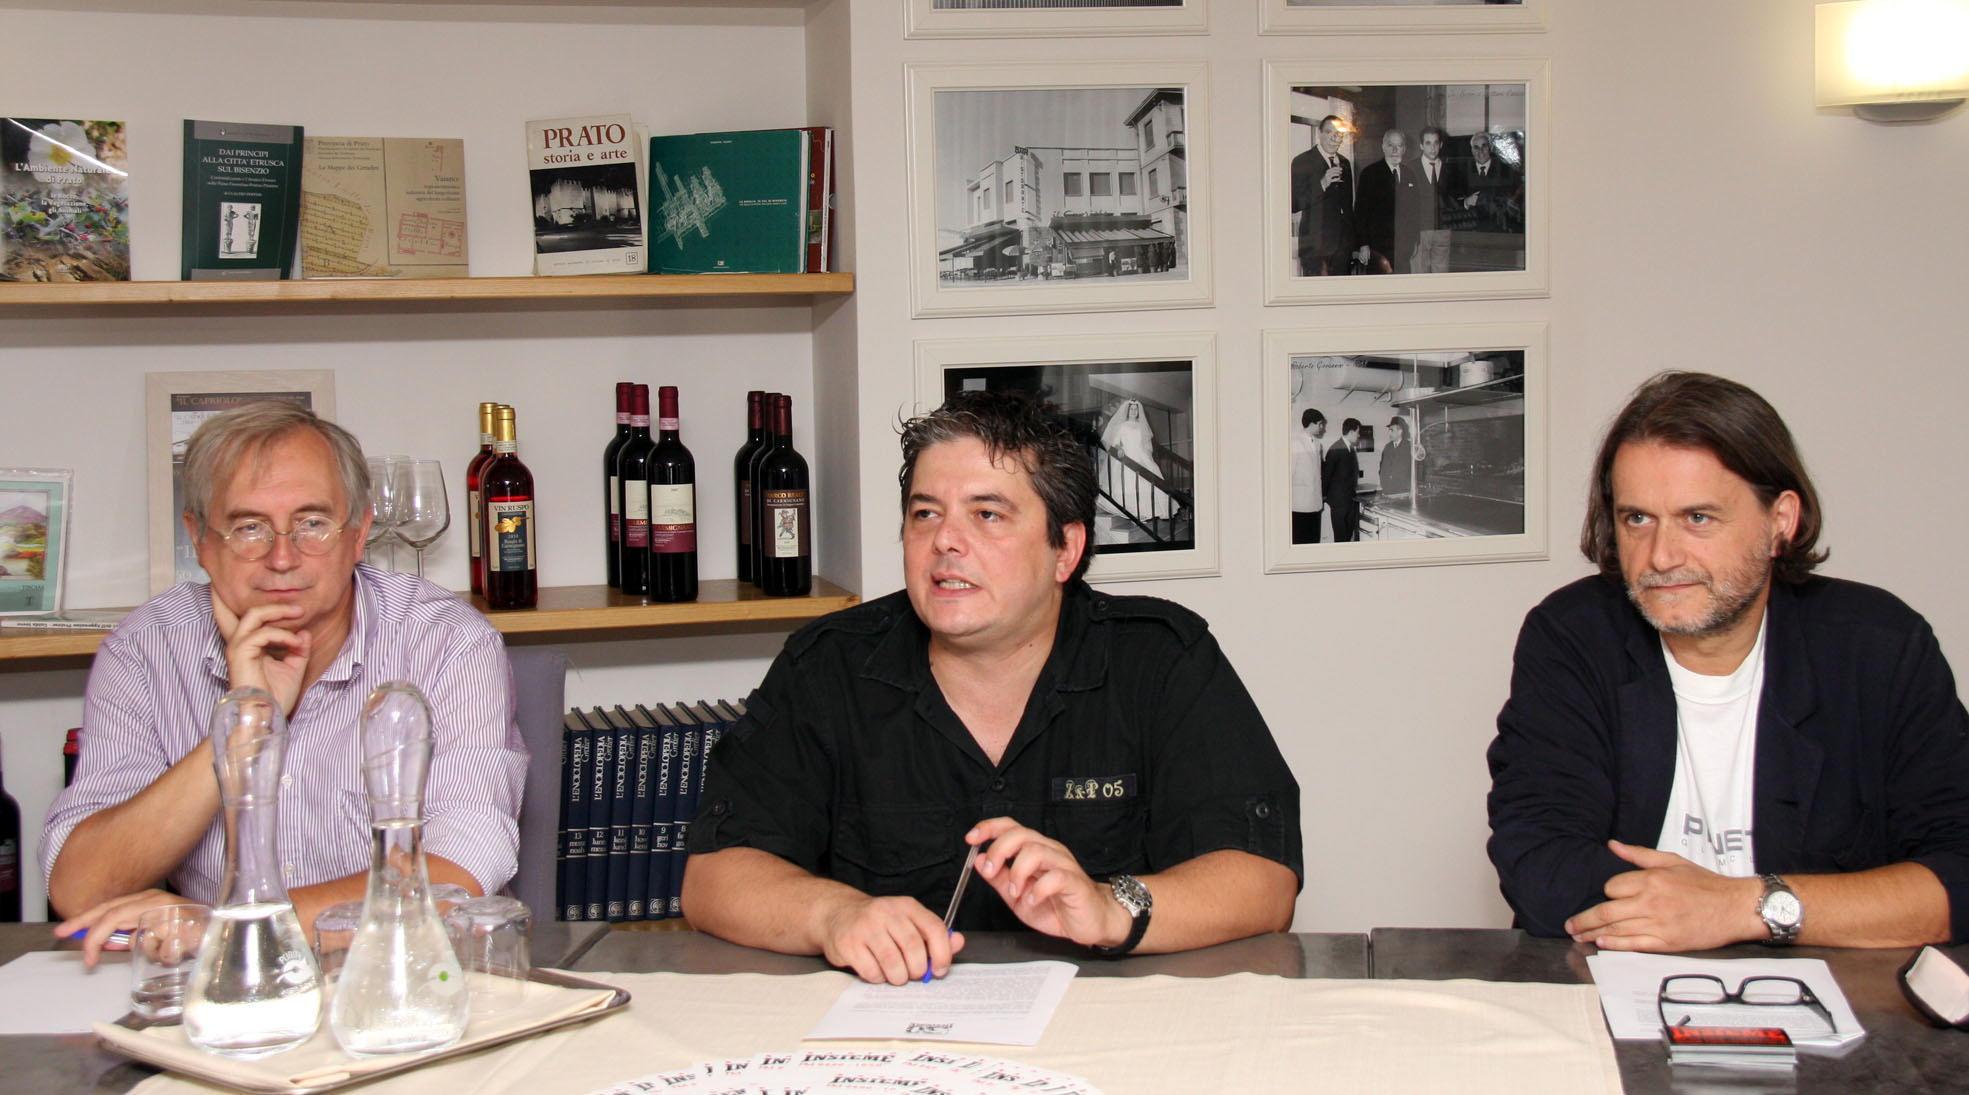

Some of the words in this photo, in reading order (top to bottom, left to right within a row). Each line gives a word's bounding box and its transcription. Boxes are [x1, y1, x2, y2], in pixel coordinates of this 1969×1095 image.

[543, 123, 626, 149] PRATO
[201, 156, 223, 164] ALLA
[250, 159, 285, 167] ETRUSCA
[219, 148, 234, 156] DAI
[236, 149, 269, 158] PRINCIPI
[543, 149, 581, 165] storia
[587, 152, 595, 161] e
[600, 149, 628, 160] arte
[217, 165, 233, 173] SUL
[234, 167, 270, 175] BISENZIO
[627, 254, 636, 262] 18
[572, 737, 582, 801] L'ENCICLOPEDIA
[594, 736, 606, 800] L'ENCICLOPEDIA
[616, 735, 628, 799] L'ENCICLOPEDIA
[638, 734, 650, 798] L'ENCICLOPEDIA
[659, 732, 671, 796] L'ENCICLOPEDIA
[680, 731, 692, 795] L'ENCICLOPEDIA
[1102, 779, 1124, 798] 05
